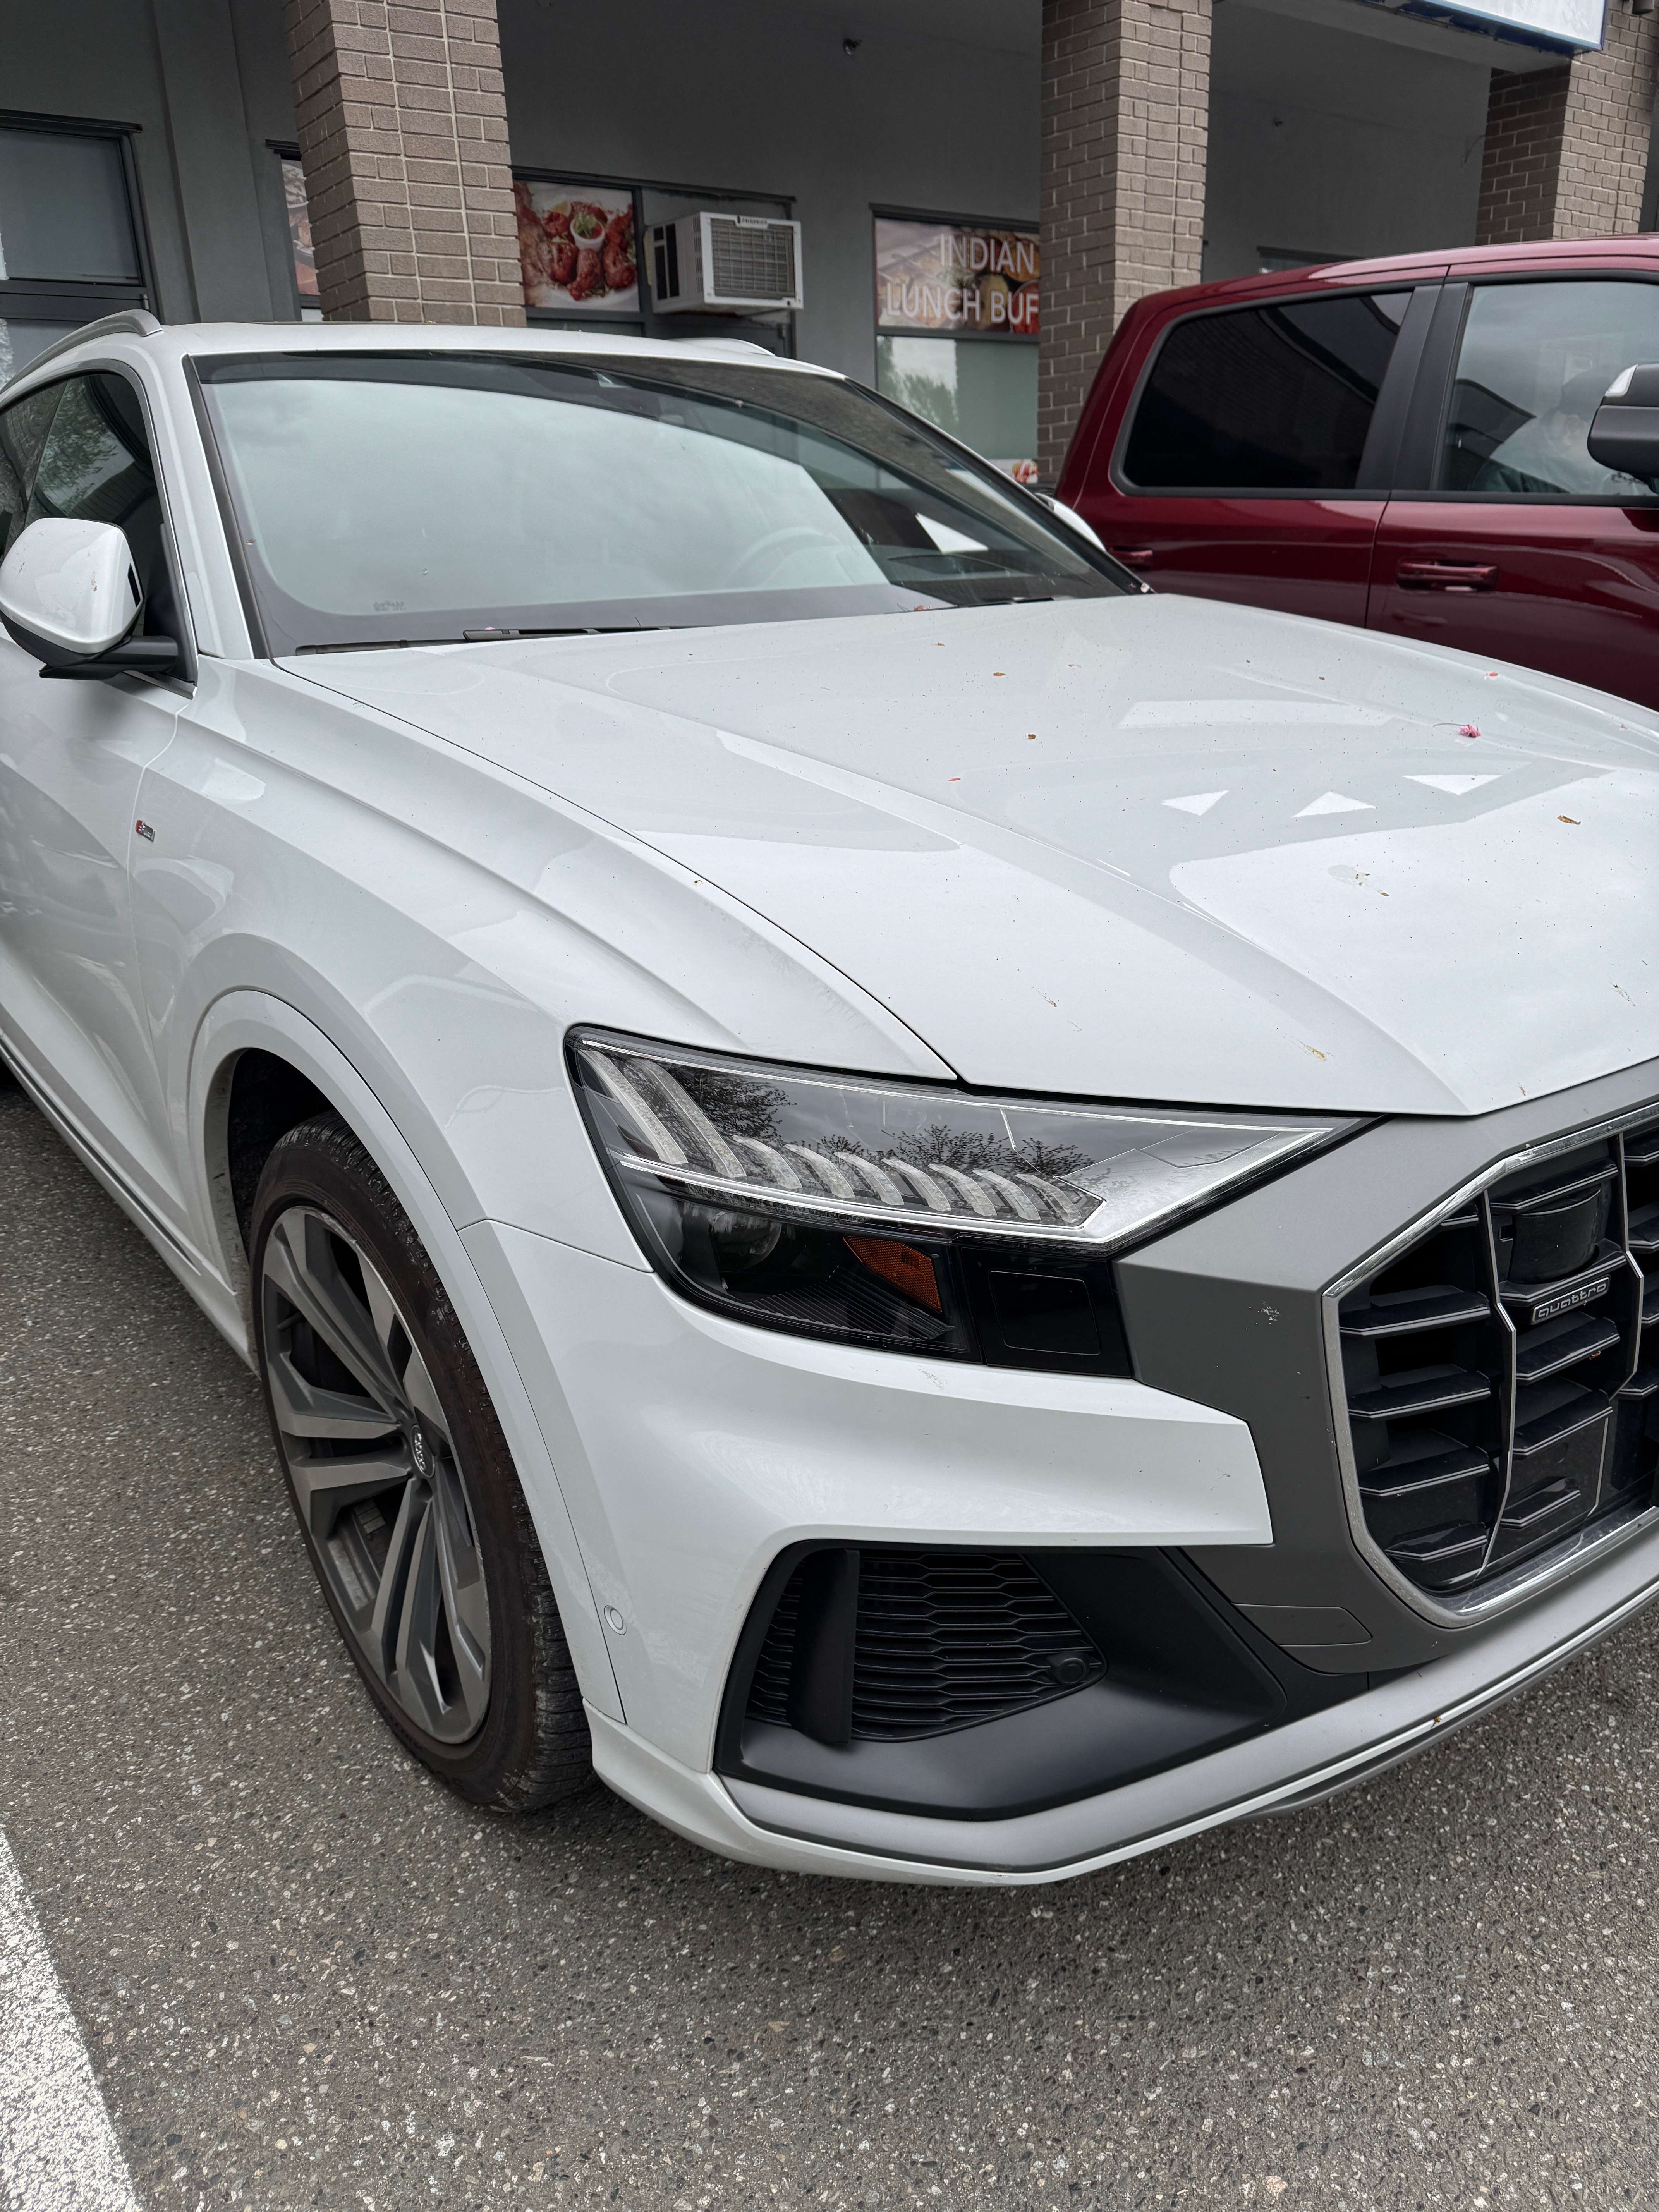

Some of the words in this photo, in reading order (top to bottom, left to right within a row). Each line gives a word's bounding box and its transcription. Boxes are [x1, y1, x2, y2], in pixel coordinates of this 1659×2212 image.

[940, 233, 1035, 274] INDIAN
[887, 283, 980, 321] LUNCH
[990, 290, 1039, 325] BUF
[1538, 1283, 1607, 1317] quattro
